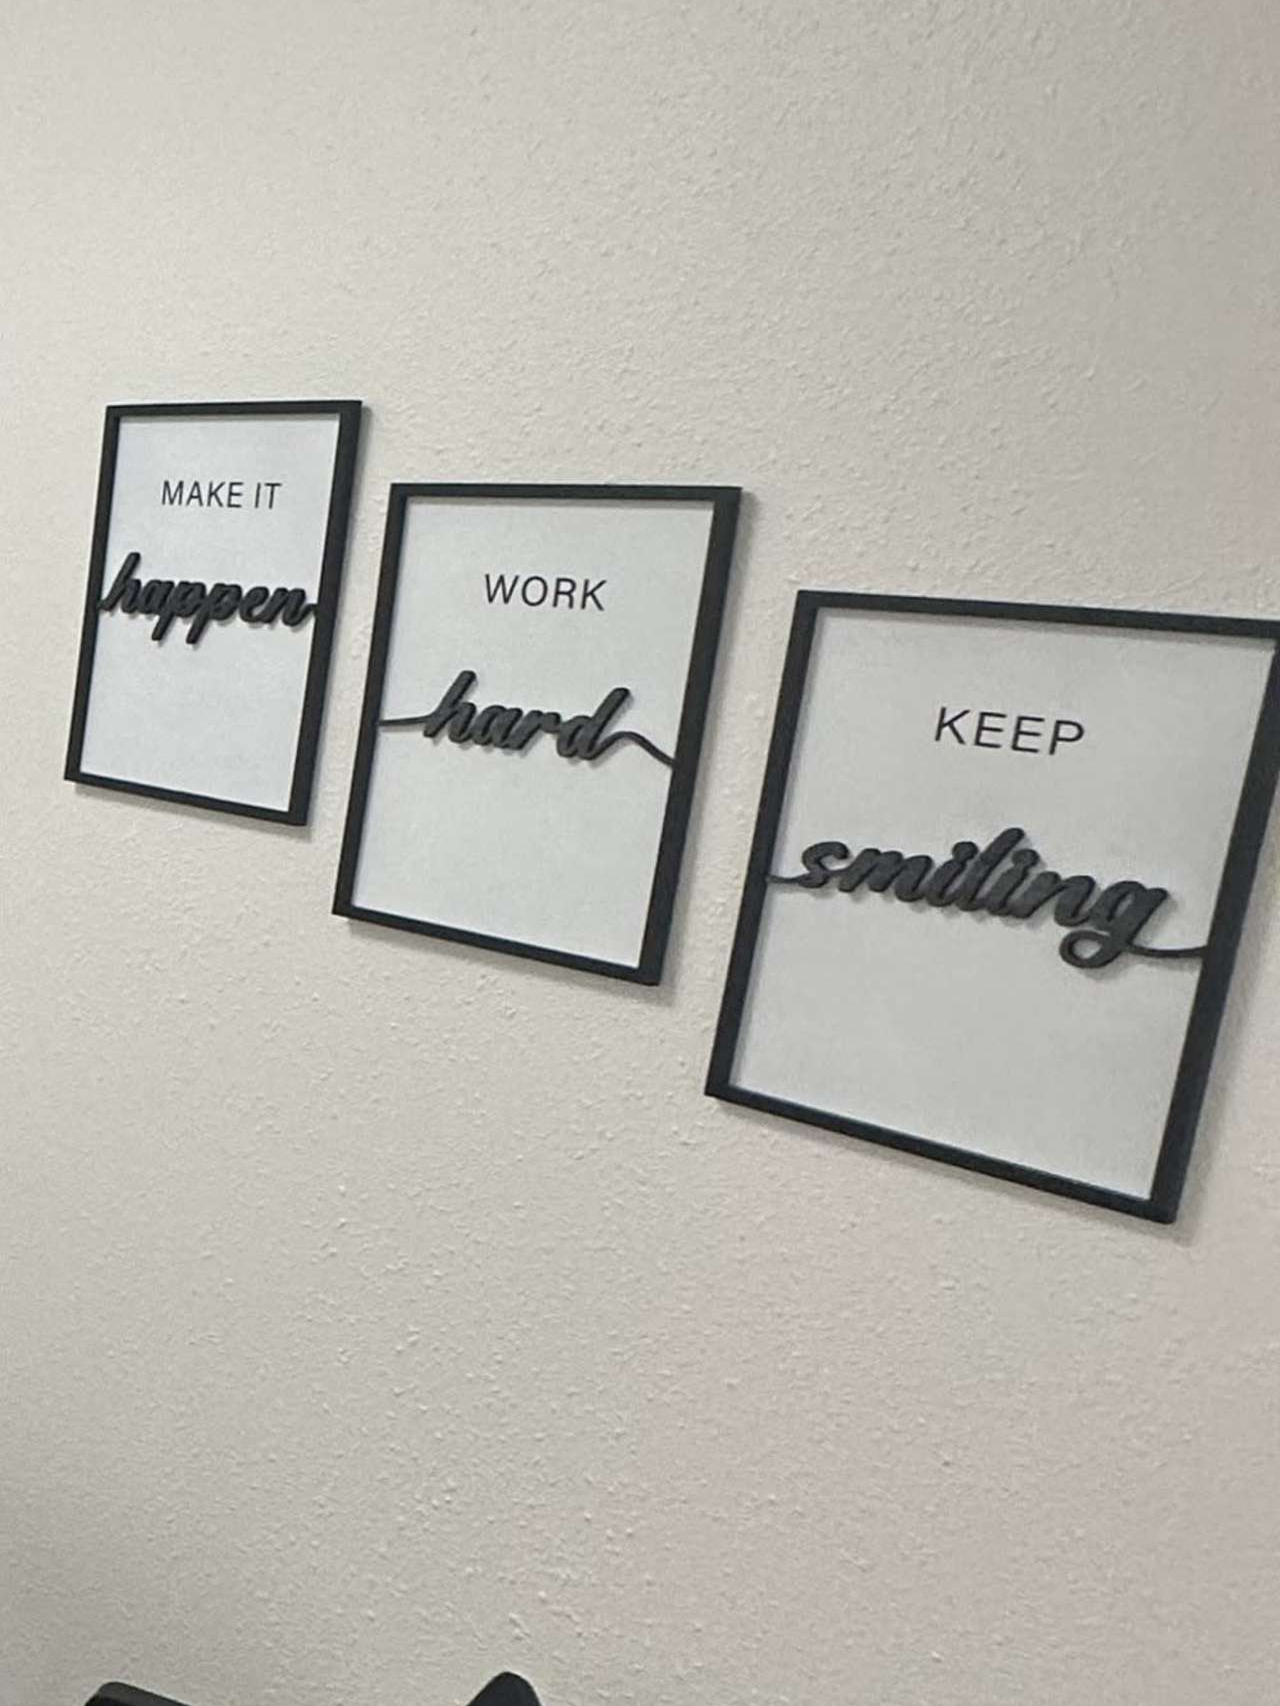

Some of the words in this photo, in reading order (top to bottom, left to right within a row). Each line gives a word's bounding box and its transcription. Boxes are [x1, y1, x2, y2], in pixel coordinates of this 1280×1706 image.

[161, 479, 245, 509] MAKE
[254, 482, 283, 510] IT
[98, 552, 316, 644] happen
[484, 573, 607, 612] WORK
[382, 670, 673, 766] hard
[934, 706, 1085, 756] KEEP
[768, 828, 1207, 968] smiling
